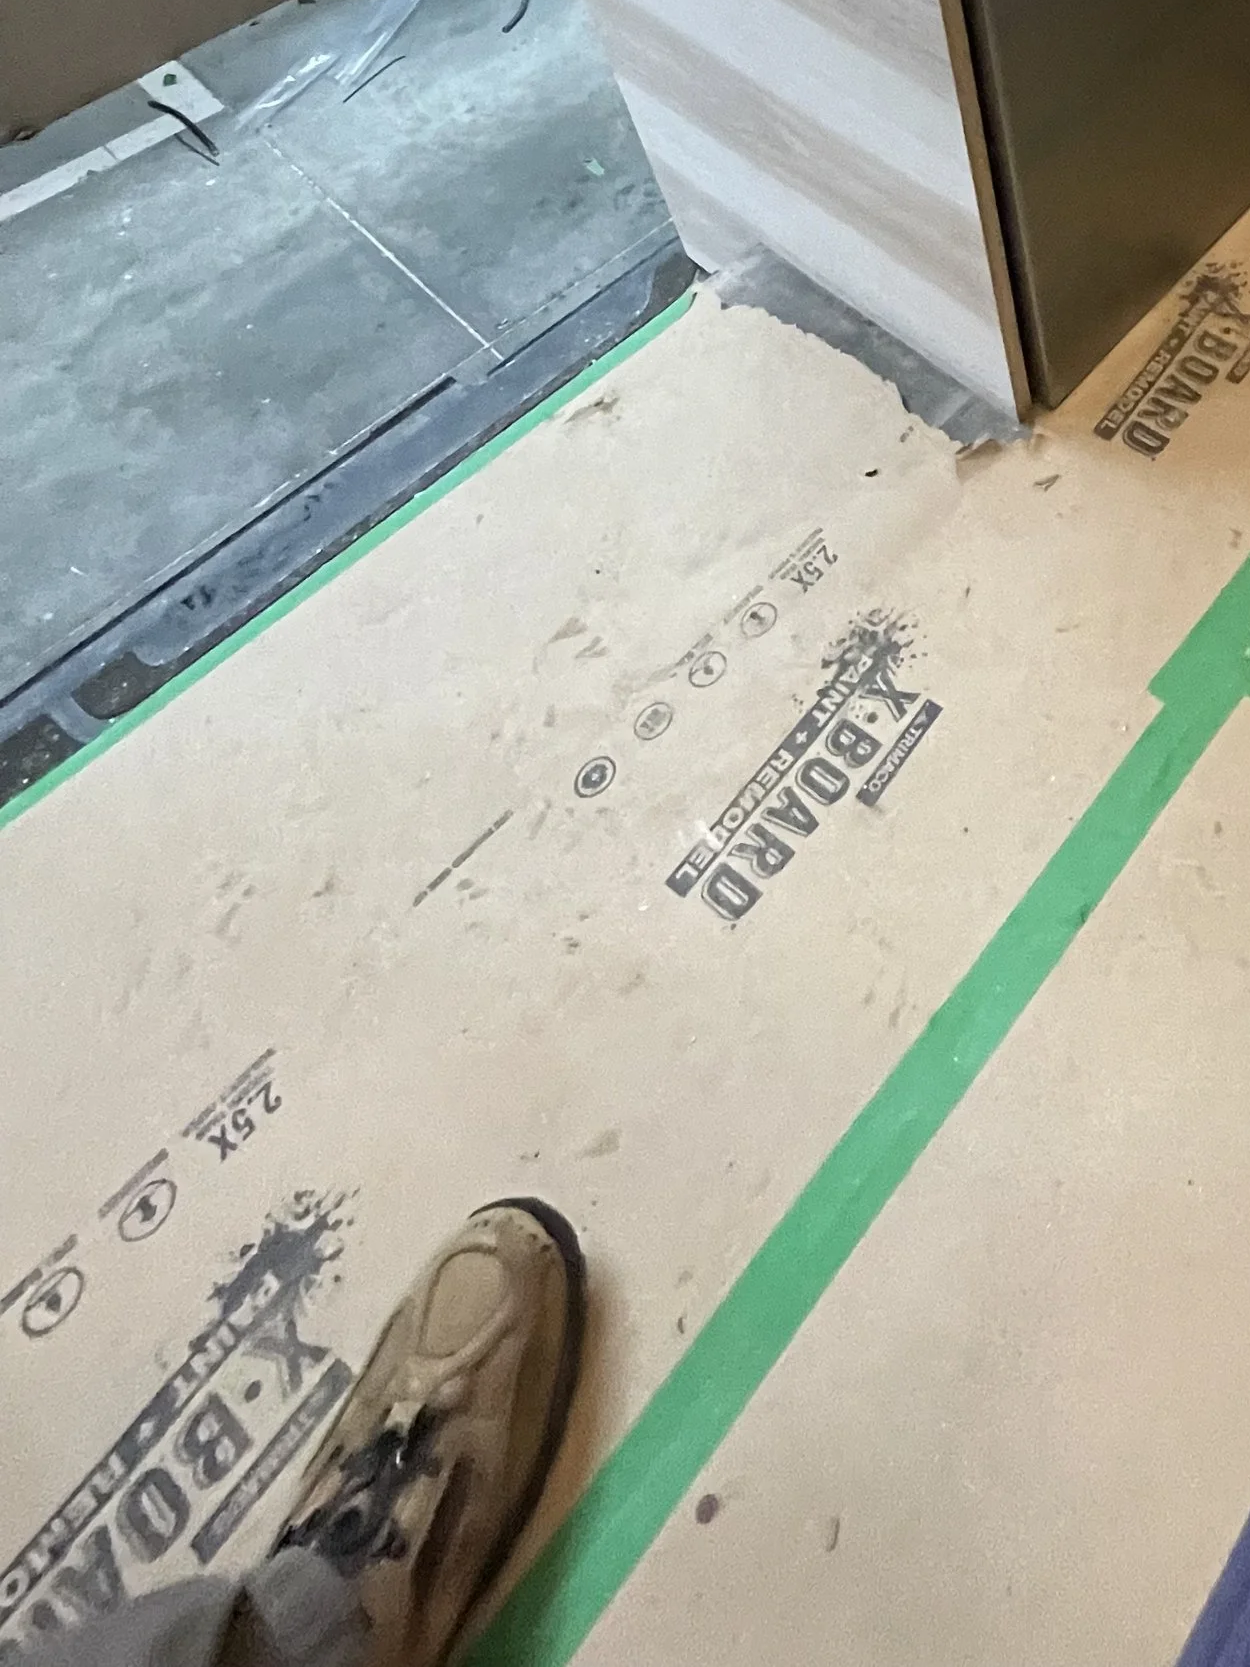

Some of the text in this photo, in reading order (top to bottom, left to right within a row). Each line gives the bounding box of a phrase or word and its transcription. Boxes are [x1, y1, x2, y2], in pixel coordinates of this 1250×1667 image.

[789, 545, 838, 593] 2.5X
[810, 655, 874, 724] PAINT
[866, 726, 923, 794] TRIMACO
[673, 749, 790, 885] REMODEL
[208, 1080, 282, 1163] 2.5X
[0, 1451, 127, 1610] REMO
